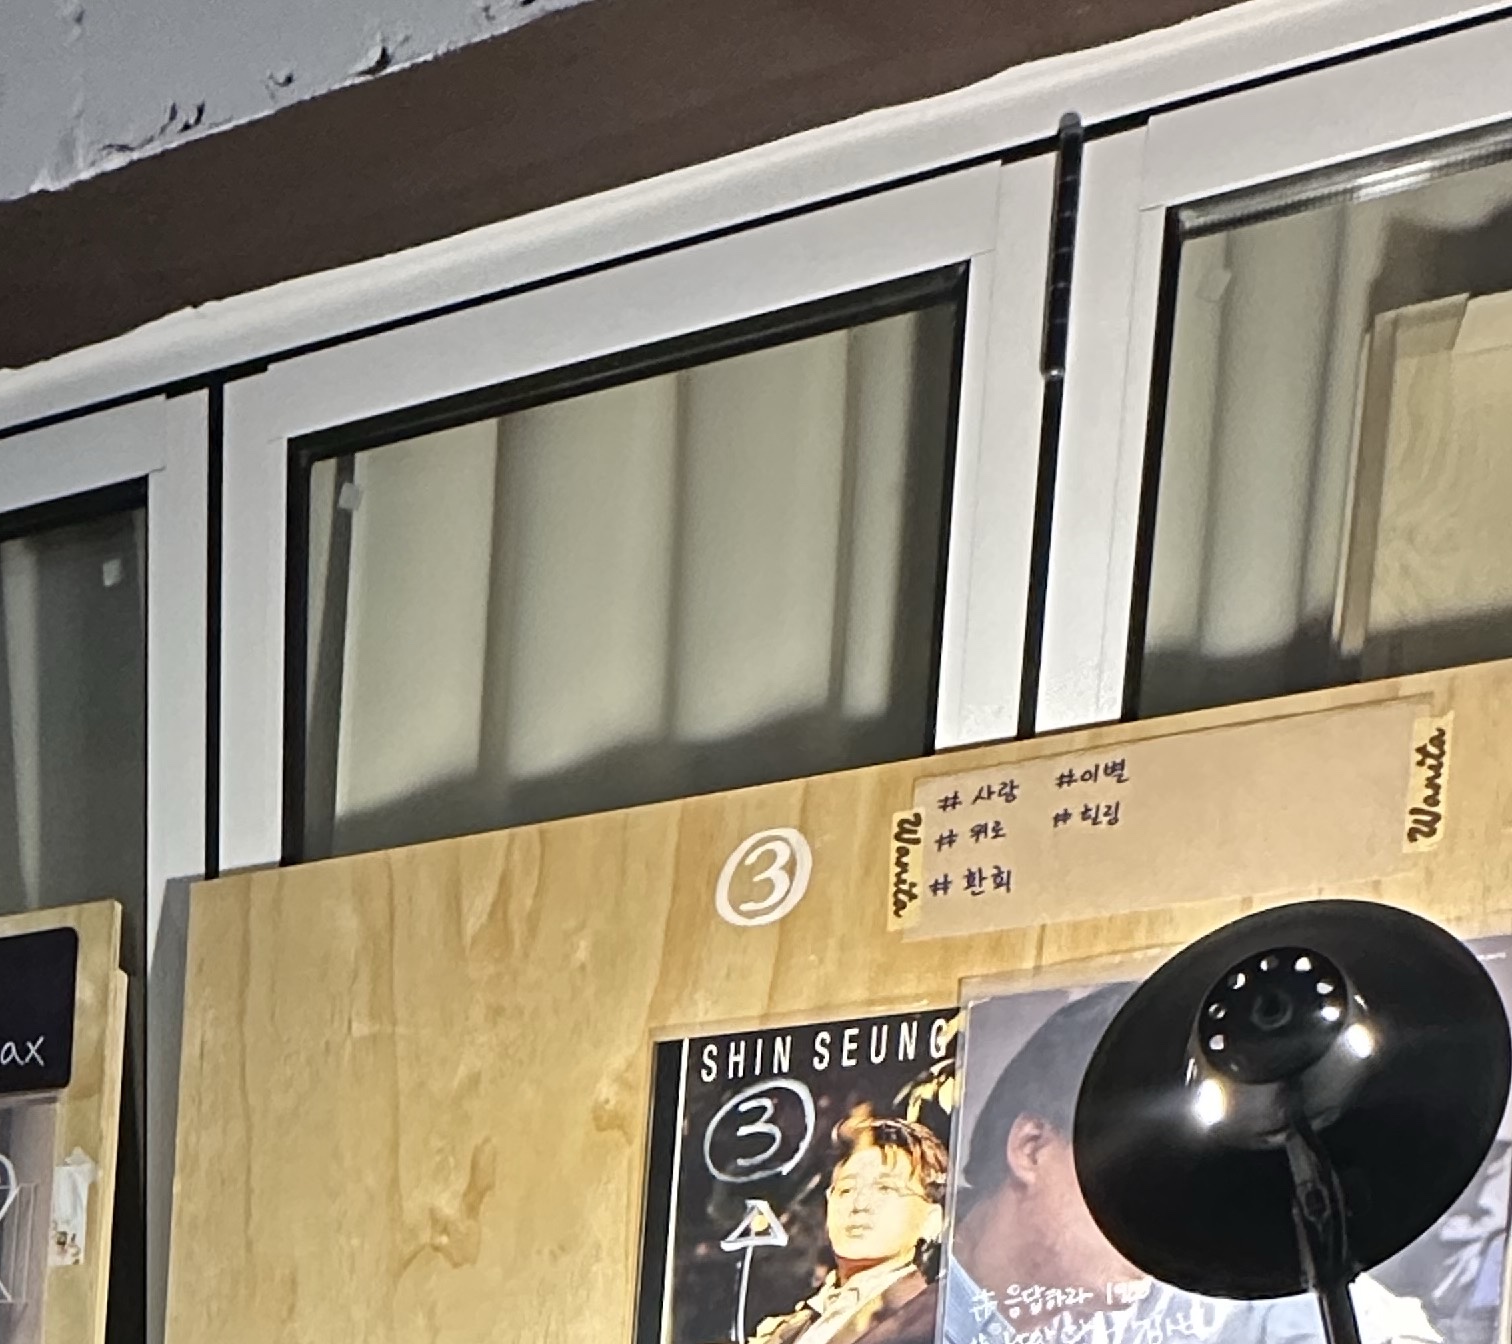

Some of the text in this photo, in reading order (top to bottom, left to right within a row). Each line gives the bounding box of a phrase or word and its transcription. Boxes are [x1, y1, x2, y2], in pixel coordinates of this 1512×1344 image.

[971, 779, 1019, 804] 사랑
[970, 820, 1006, 843] 위로
[700, 1017, 949, 1083] SHIN SEUNG
